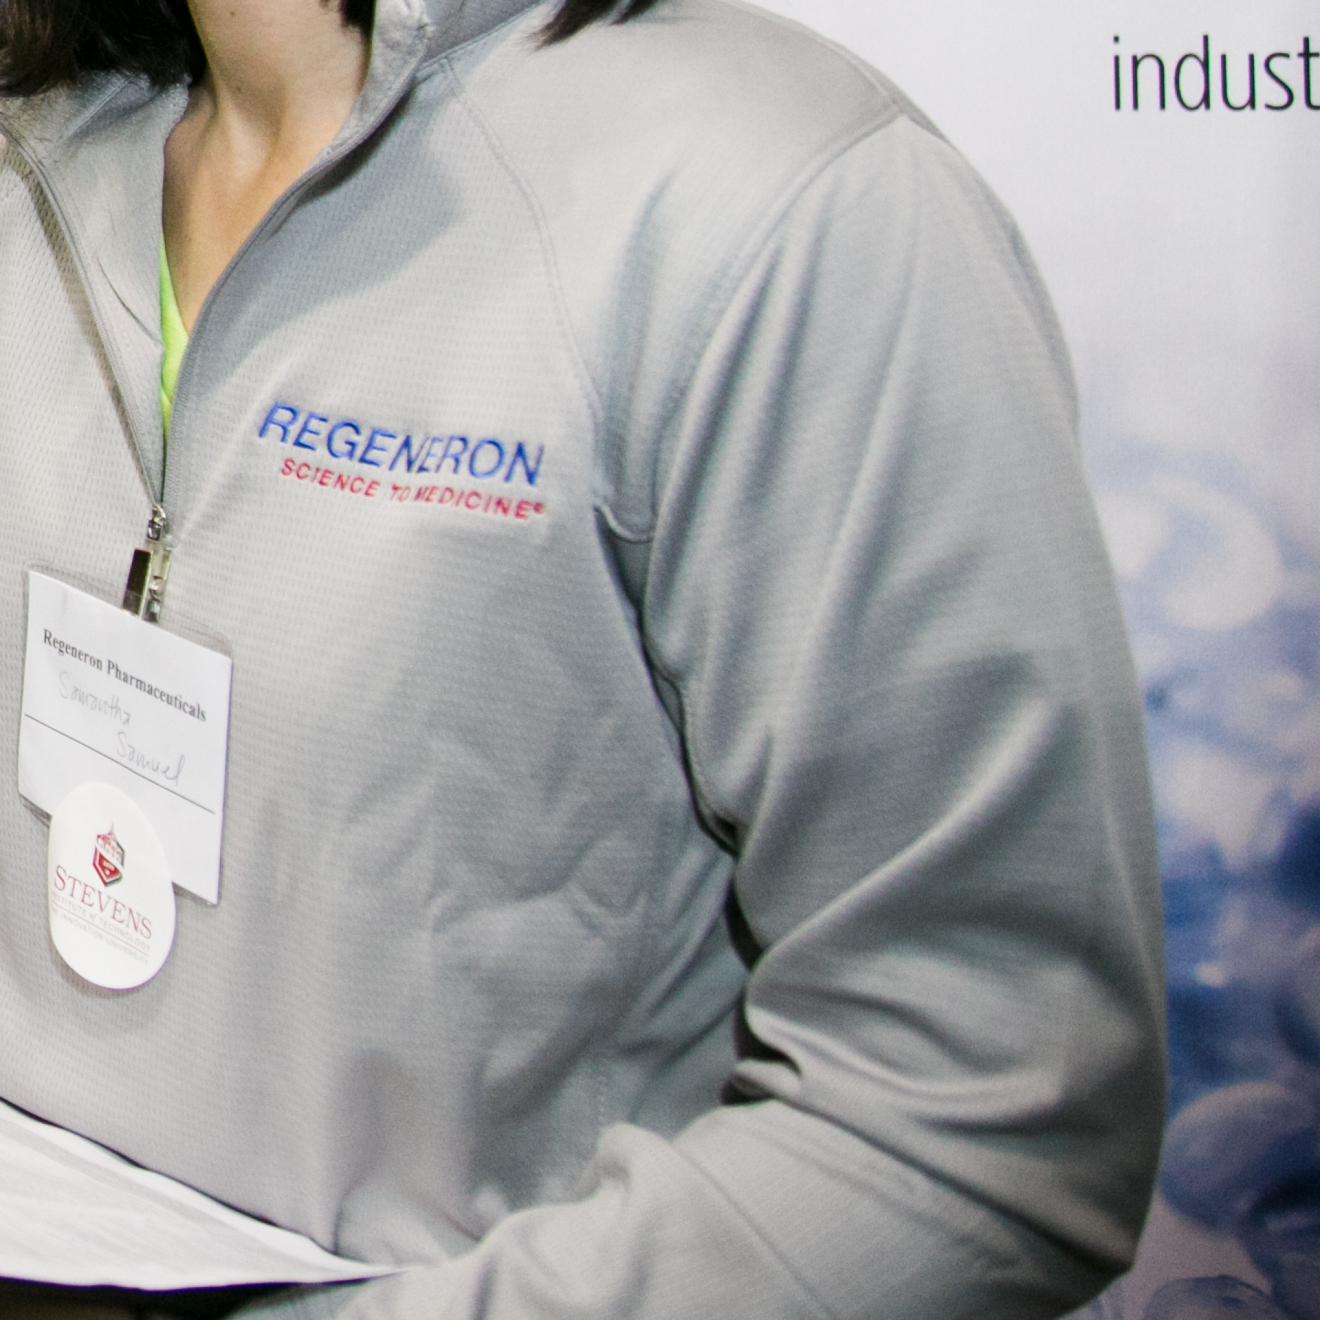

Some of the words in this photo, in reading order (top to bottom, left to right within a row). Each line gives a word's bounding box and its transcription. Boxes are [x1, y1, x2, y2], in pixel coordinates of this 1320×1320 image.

[1114, 34, 1320, 111] indust
[258, 401, 544, 487] REGENERON
[280, 457, 380, 498] SCIENCE
[390, 483, 411, 503] TO
[43, 628, 103, 671] Regeneron
[106, 658, 207, 722] Pharmaceuticals
[54, 865, 153, 940] STEVENS
[99, 916, 151, 953] TECHNOLOGY
